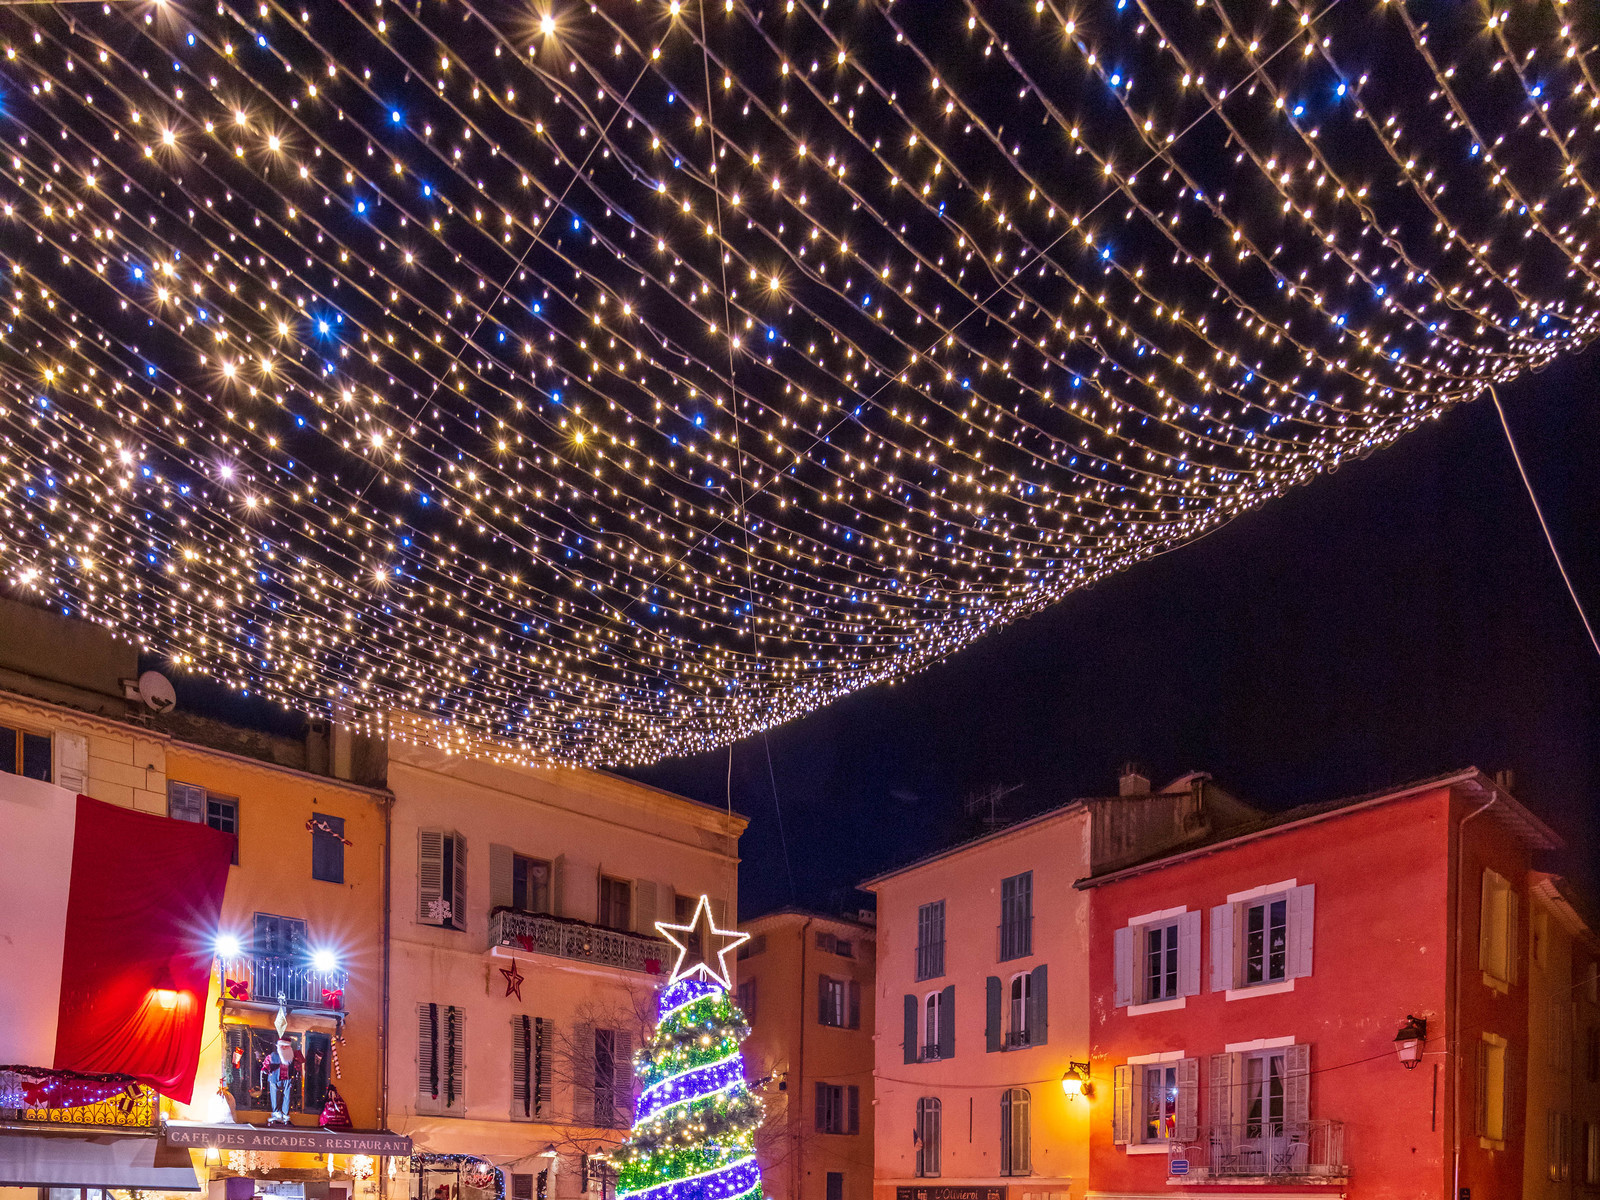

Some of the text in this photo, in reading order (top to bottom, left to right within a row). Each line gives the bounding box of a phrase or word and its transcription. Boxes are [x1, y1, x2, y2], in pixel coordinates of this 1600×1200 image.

[171, 1131, 210, 1143] CAFE
[217, 1133, 246, 1144] DES
[251, 1135, 316, 1147] ARCADES
[326, 1138, 409, 1151] RESTAURANT
